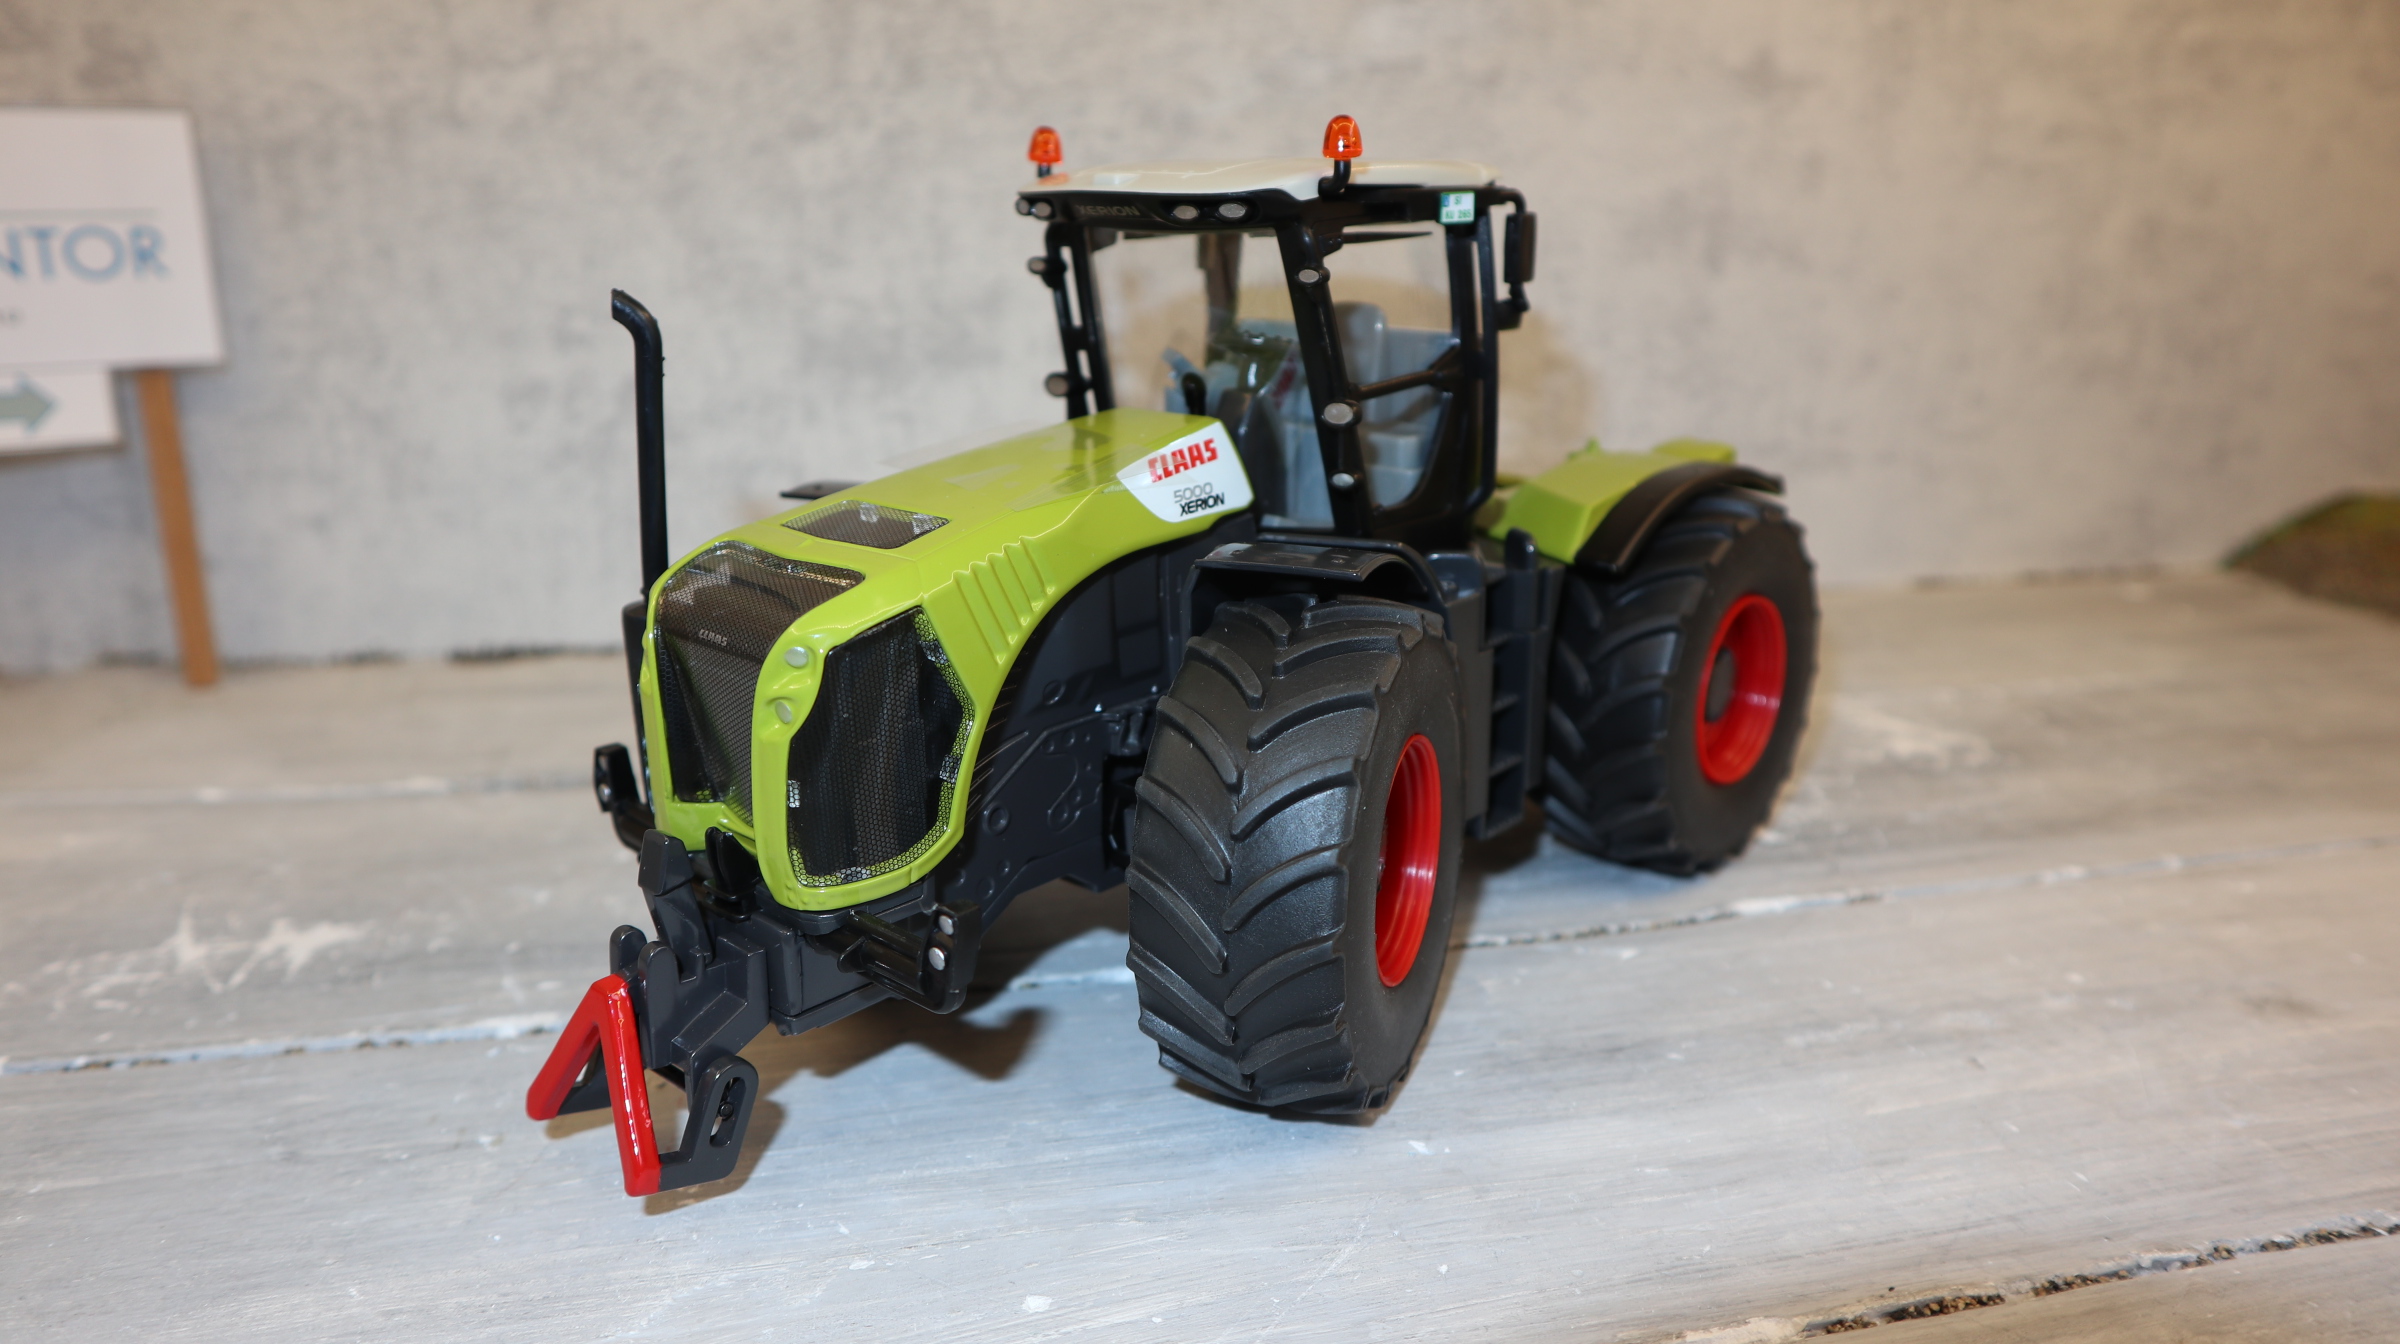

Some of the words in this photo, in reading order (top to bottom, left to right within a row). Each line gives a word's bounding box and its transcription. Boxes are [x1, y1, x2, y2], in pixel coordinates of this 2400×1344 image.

[1147, 438, 1218, 483] CLAAS
[1173, 482, 1213, 503] 5000
[1180, 492, 1225, 516] XERION
[699, 629, 727, 646] CLAAS
